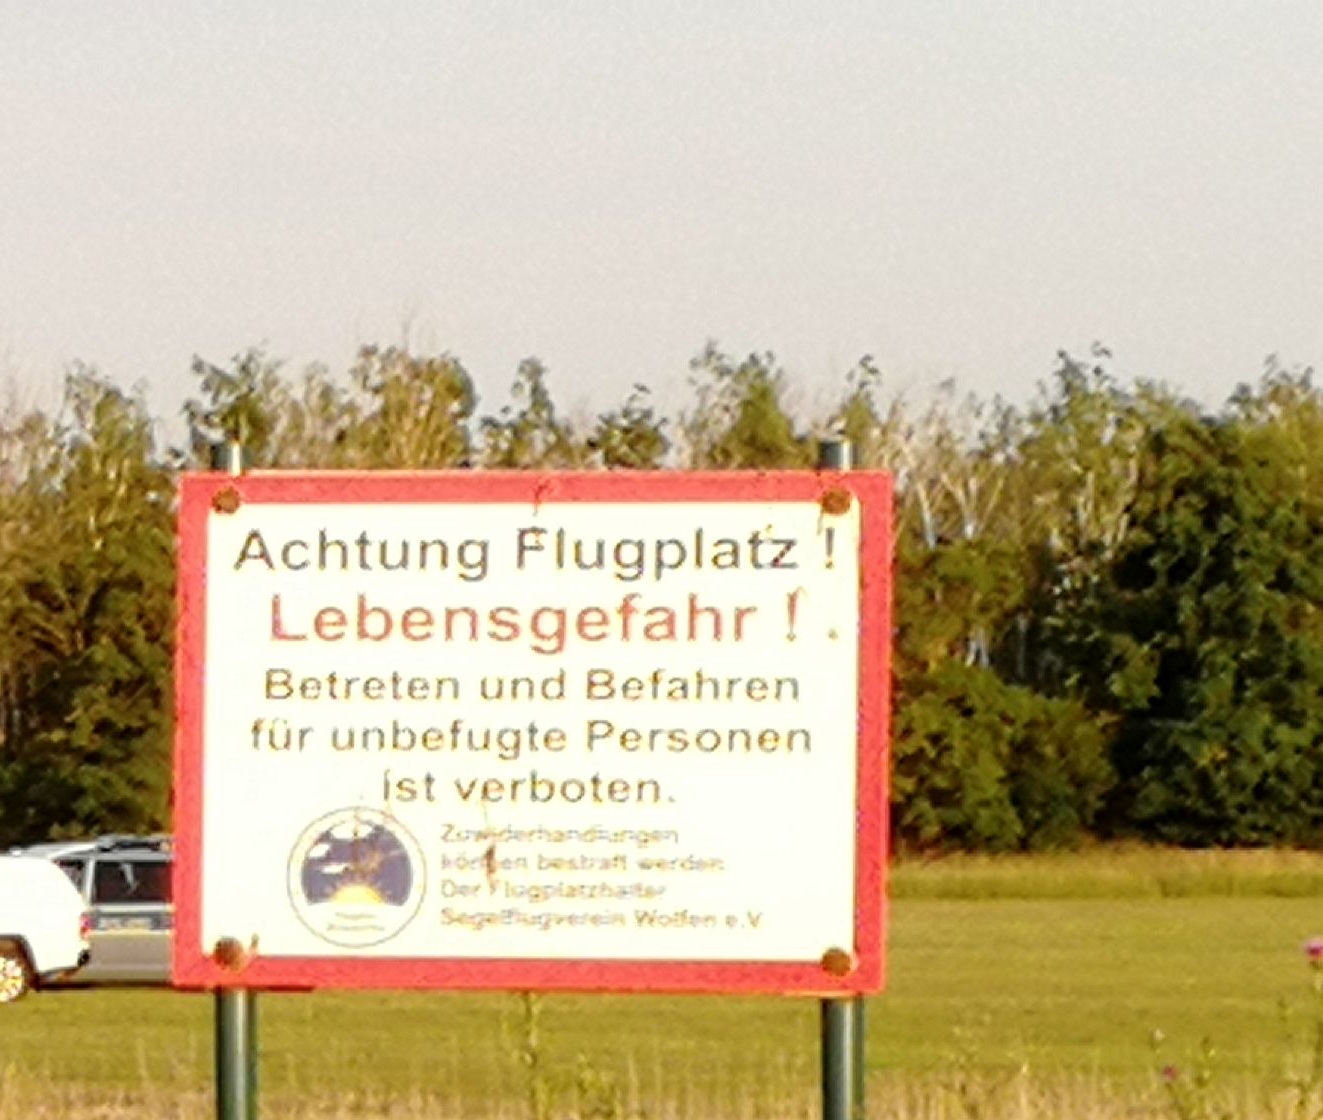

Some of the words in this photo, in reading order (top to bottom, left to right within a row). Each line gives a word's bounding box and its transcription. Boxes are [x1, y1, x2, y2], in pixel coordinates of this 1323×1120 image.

[234, 527, 488, 581] Achtung
[516, 527, 798, 582] Flugplatz
[825, 527, 835, 569] !
[271, 593, 757, 655] Lebensgefahr
[787, 591, 798, 642] !
[265, 668, 459, 700] Betreten
[480, 668, 565, 700] und
[586, 668, 799, 701] Befahren
[251, 718, 311, 751] für
[332, 719, 566, 761] unbefugte
[587, 719, 811, 753] Personen
[383, 773, 435, 802] ist
[454, 772, 676, 803] verboten.
[440, 852, 528, 871] könen
[440, 878, 481, 898] Der
